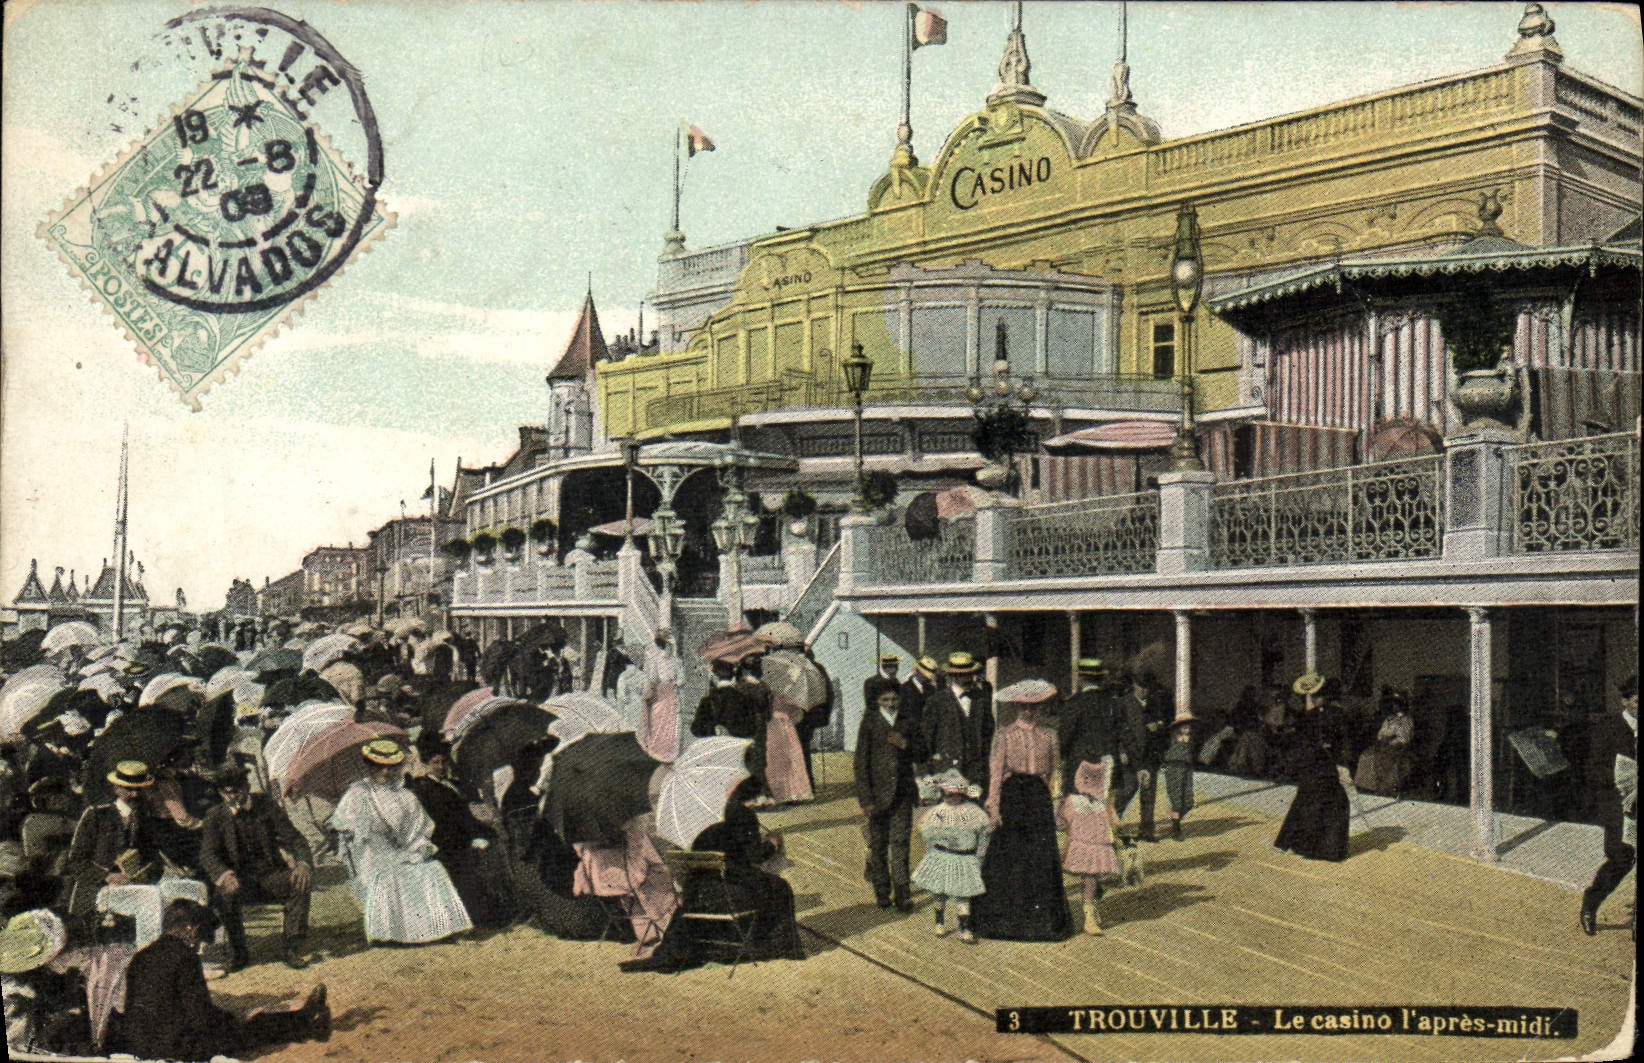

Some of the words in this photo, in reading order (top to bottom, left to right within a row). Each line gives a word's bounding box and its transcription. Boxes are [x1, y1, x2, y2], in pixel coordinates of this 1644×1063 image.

[951, 156, 1051, 210] CASINO
[89, 262, 164, 342] POSTES
[764, 270, 812, 290] ASINO
